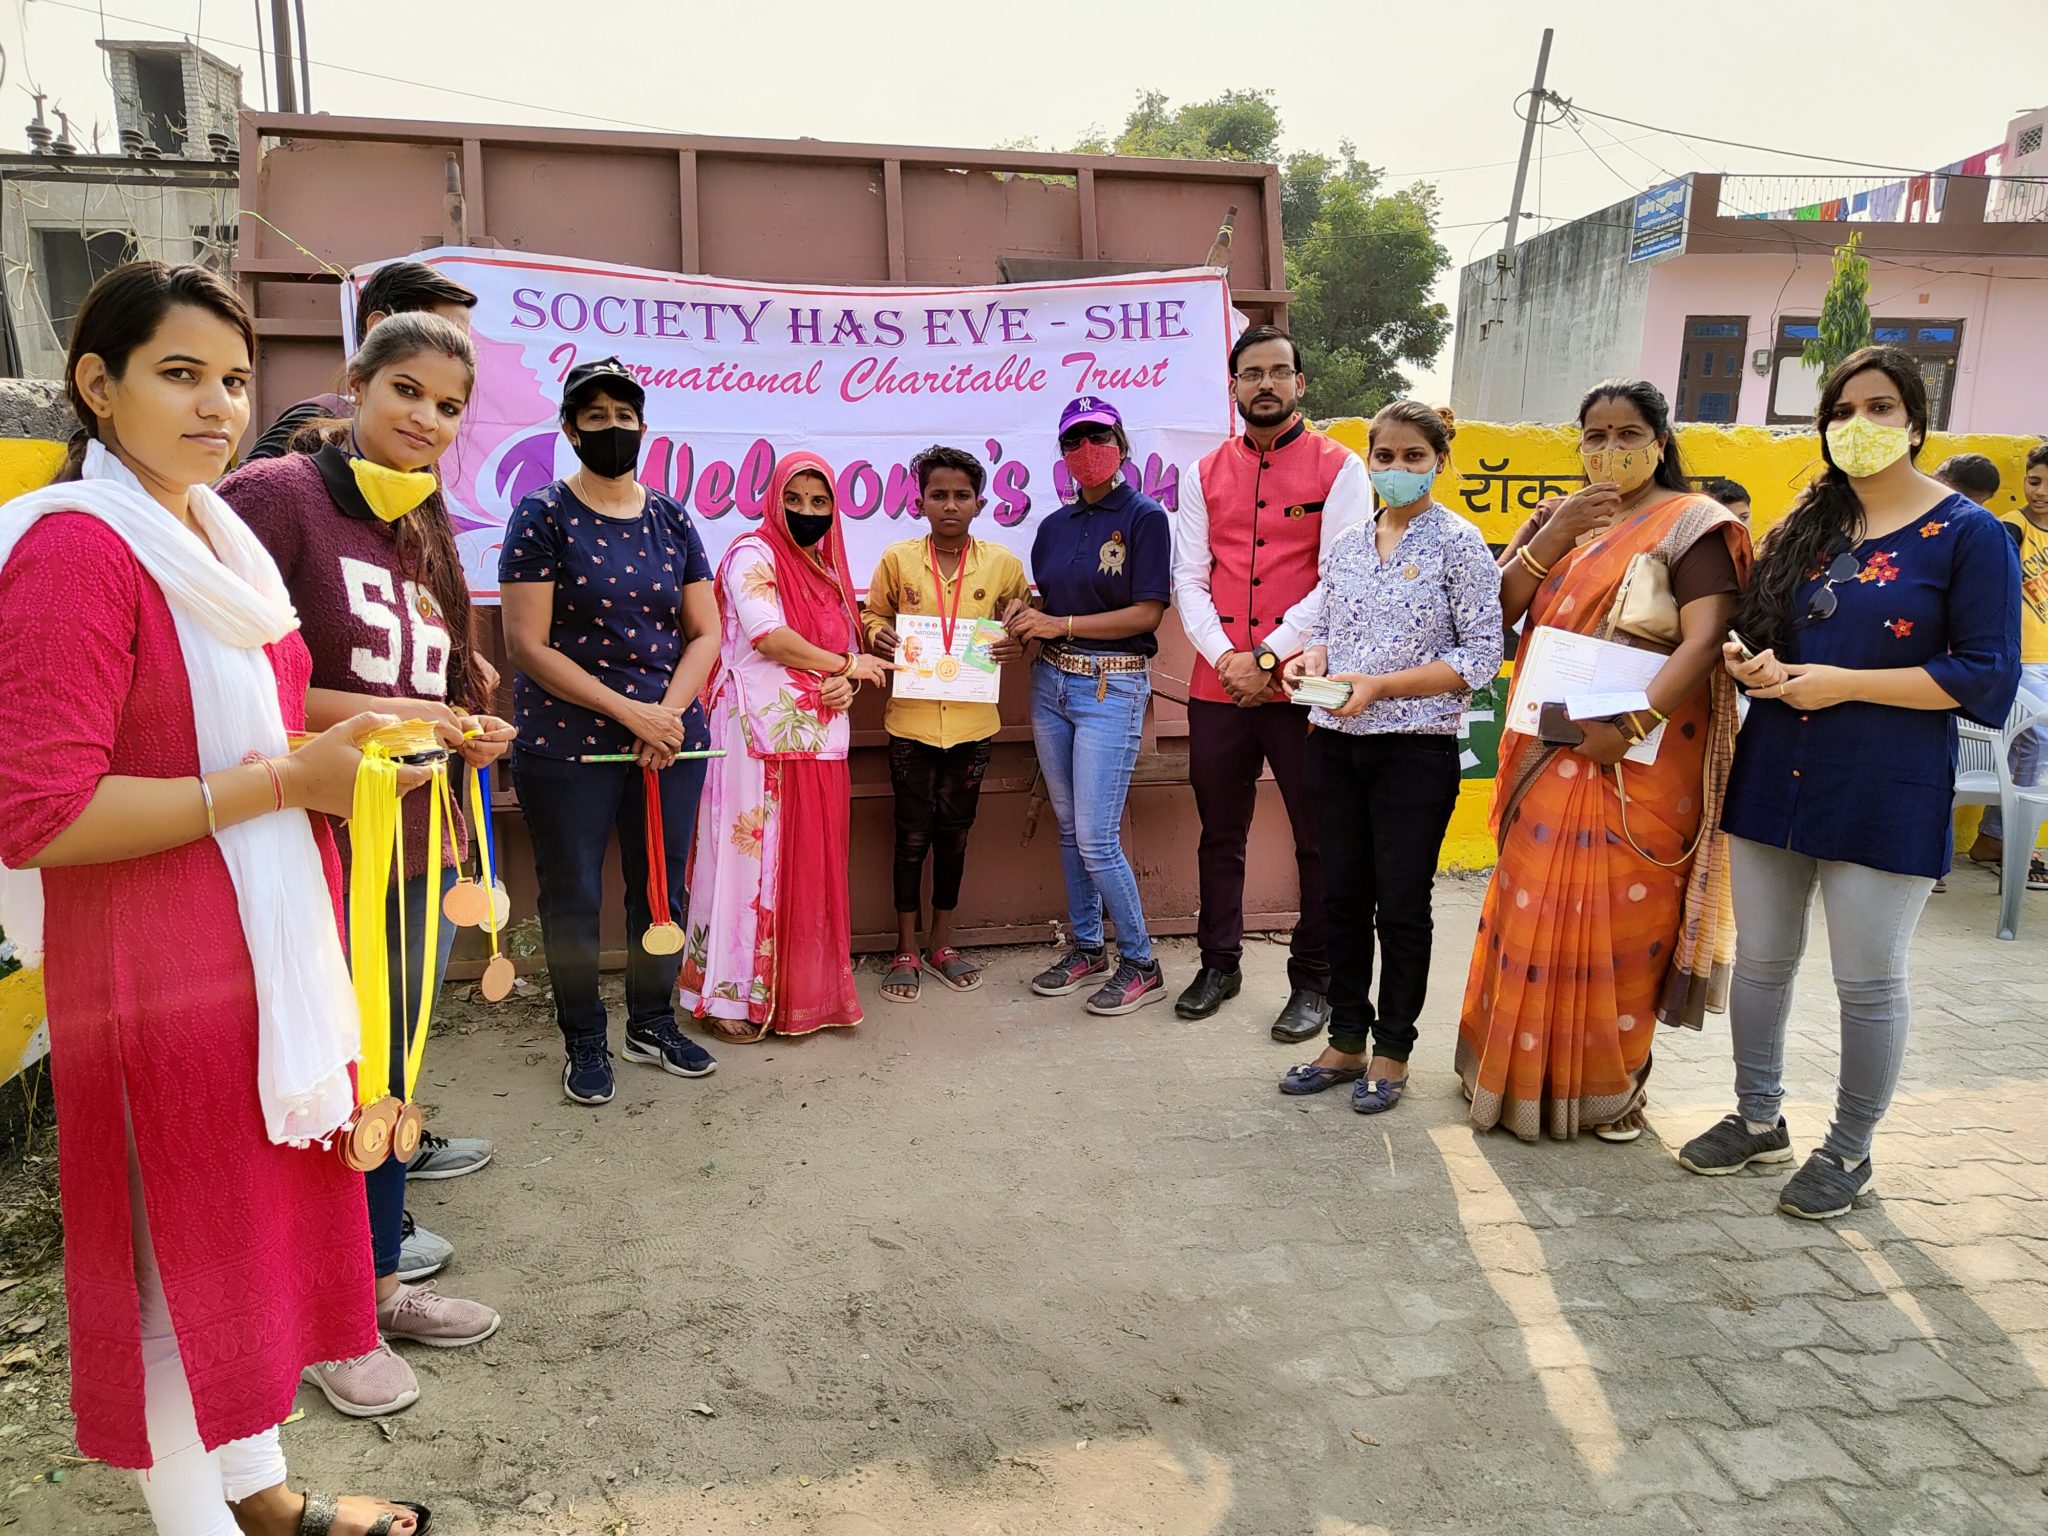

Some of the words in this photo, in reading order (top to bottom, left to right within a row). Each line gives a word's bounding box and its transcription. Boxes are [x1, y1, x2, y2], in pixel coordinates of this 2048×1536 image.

[511, 287, 775, 348] SOCIETY
[787, 307, 908, 347] HAS
[922, 301, 1038, 347] EVE
[1085, 300, 1194, 342] SHE
[549, 342, 822, 394] Irnational
[839, 352, 1048, 403] Charitable
[1062, 351, 1169, 394] Trust
[338, 556, 452, 696] 56
